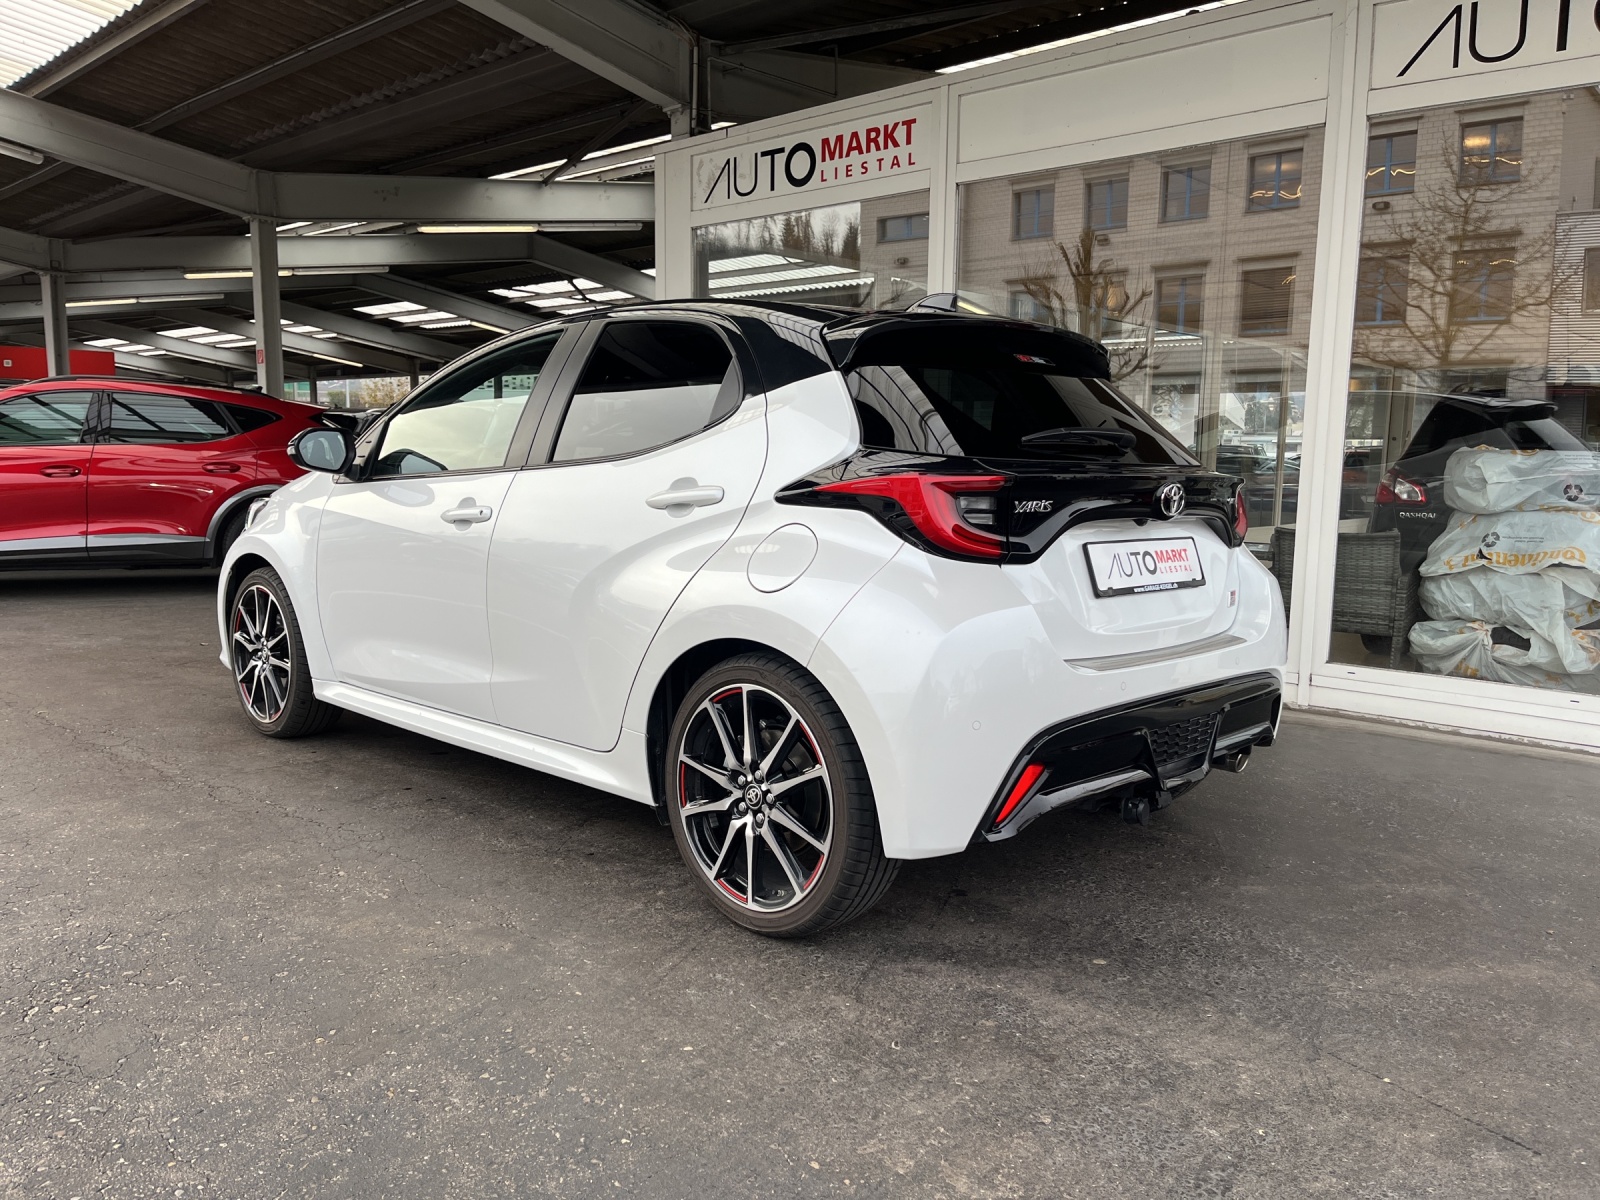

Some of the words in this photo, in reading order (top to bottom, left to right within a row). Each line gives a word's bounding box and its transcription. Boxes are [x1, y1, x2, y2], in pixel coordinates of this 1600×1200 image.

[704, 142, 817, 203] AUTO
[821, 118, 917, 162] MARKT
[820, 152, 916, 182] LIESTAL
[1013, 500, 1053, 513] YARIS
[1399, 511, 1436, 519] QASHQAI
[1108, 550, 1157, 579] AUTO
[1154, 548, 1189, 564] MARKT
[1159, 565, 1193, 574] LIESTAL
